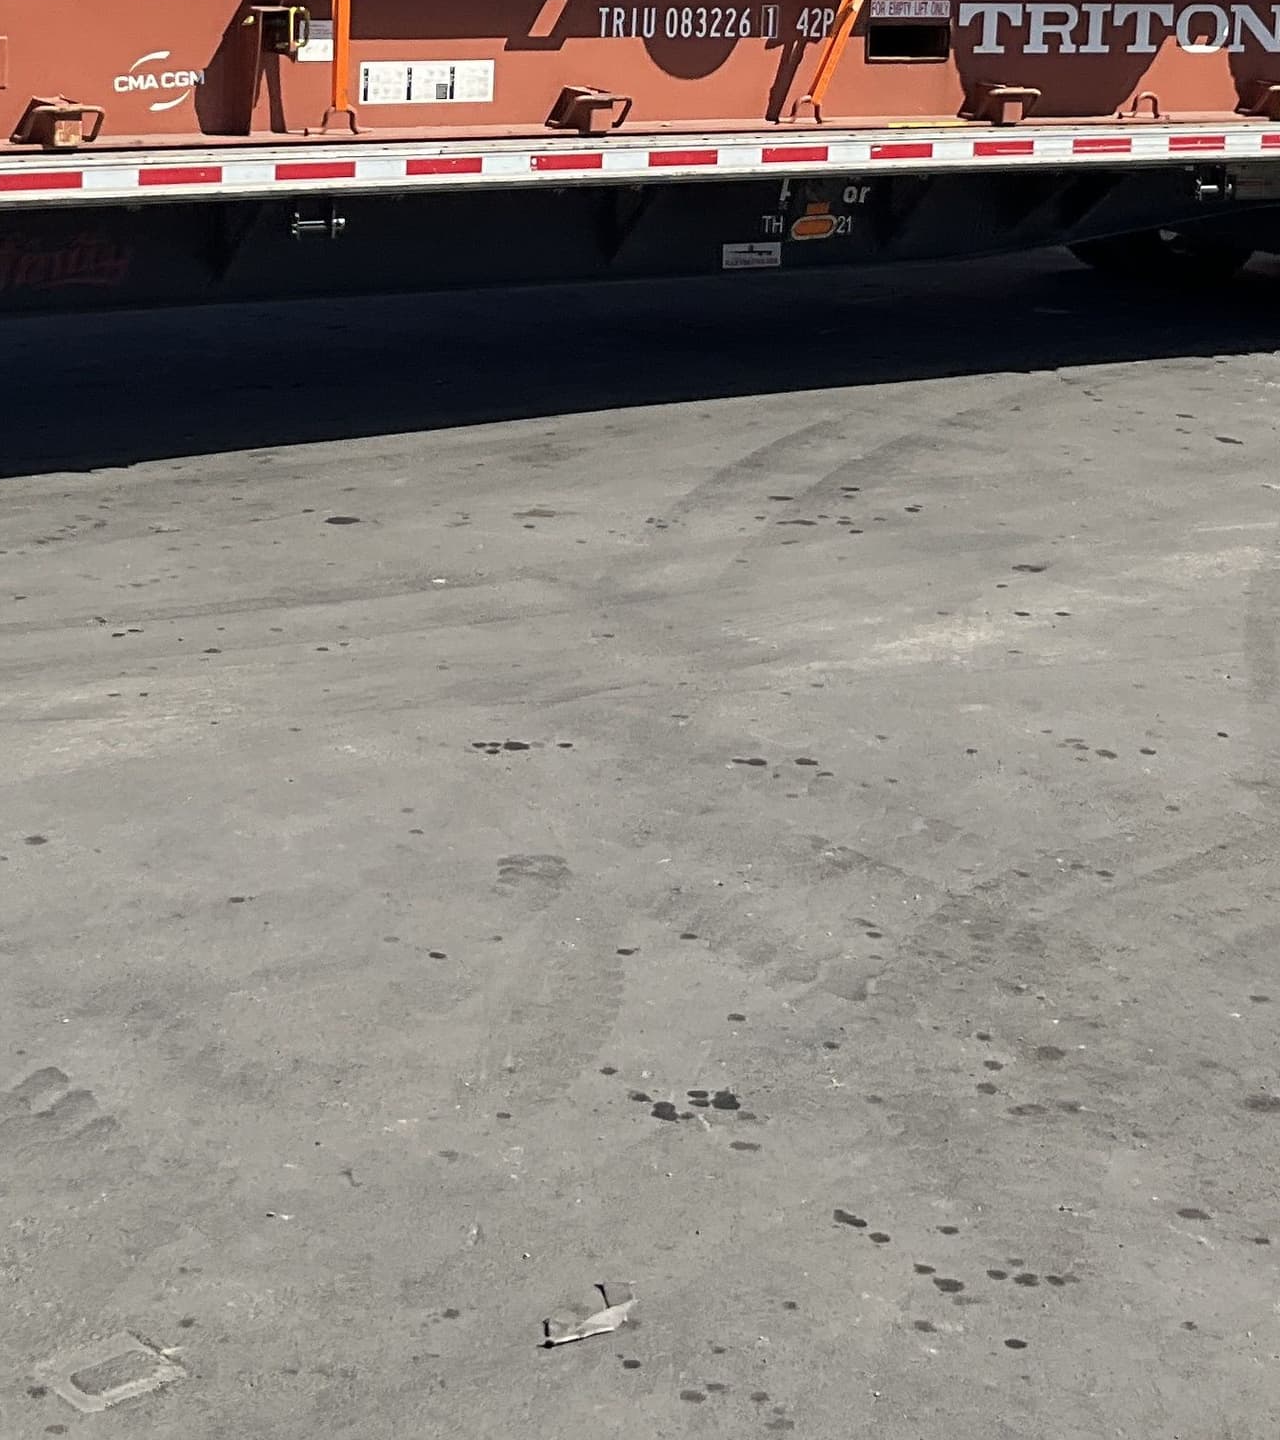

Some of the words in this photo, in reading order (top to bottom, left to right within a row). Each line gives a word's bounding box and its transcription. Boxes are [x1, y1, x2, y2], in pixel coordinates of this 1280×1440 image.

[871, 1, 885, 15] FOR
[599, 7, 657, 39] TRIU
[665, 7, 752, 39] 083226
[795, 7, 835, 37] 42P
[113, 74, 159, 92] CMA
[160, 70, 205, 88] CGM
